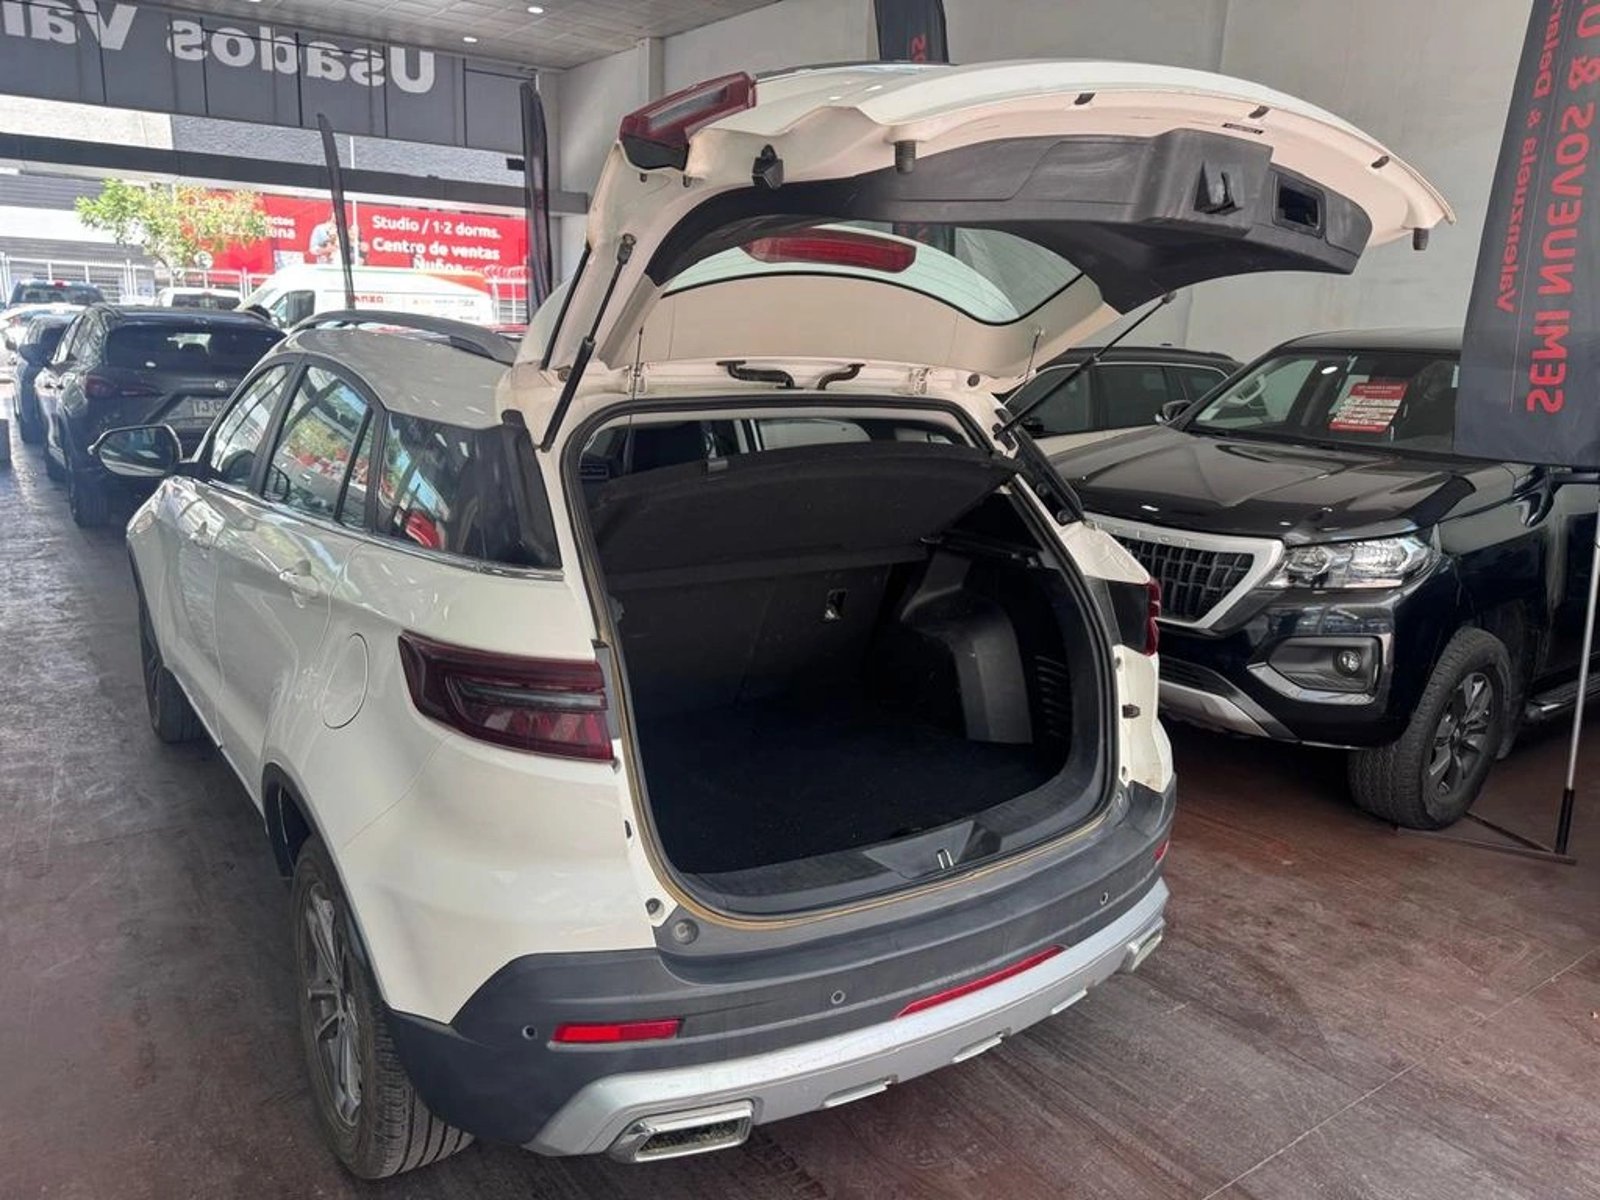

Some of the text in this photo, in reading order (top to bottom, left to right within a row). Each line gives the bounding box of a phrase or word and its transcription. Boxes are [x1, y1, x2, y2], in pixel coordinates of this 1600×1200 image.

[372, 214, 419, 232] Studio
[421, 219, 429, 235] /
[456, 223, 501, 239] dorms.
[372, 237, 500, 261] Centro de ventas
